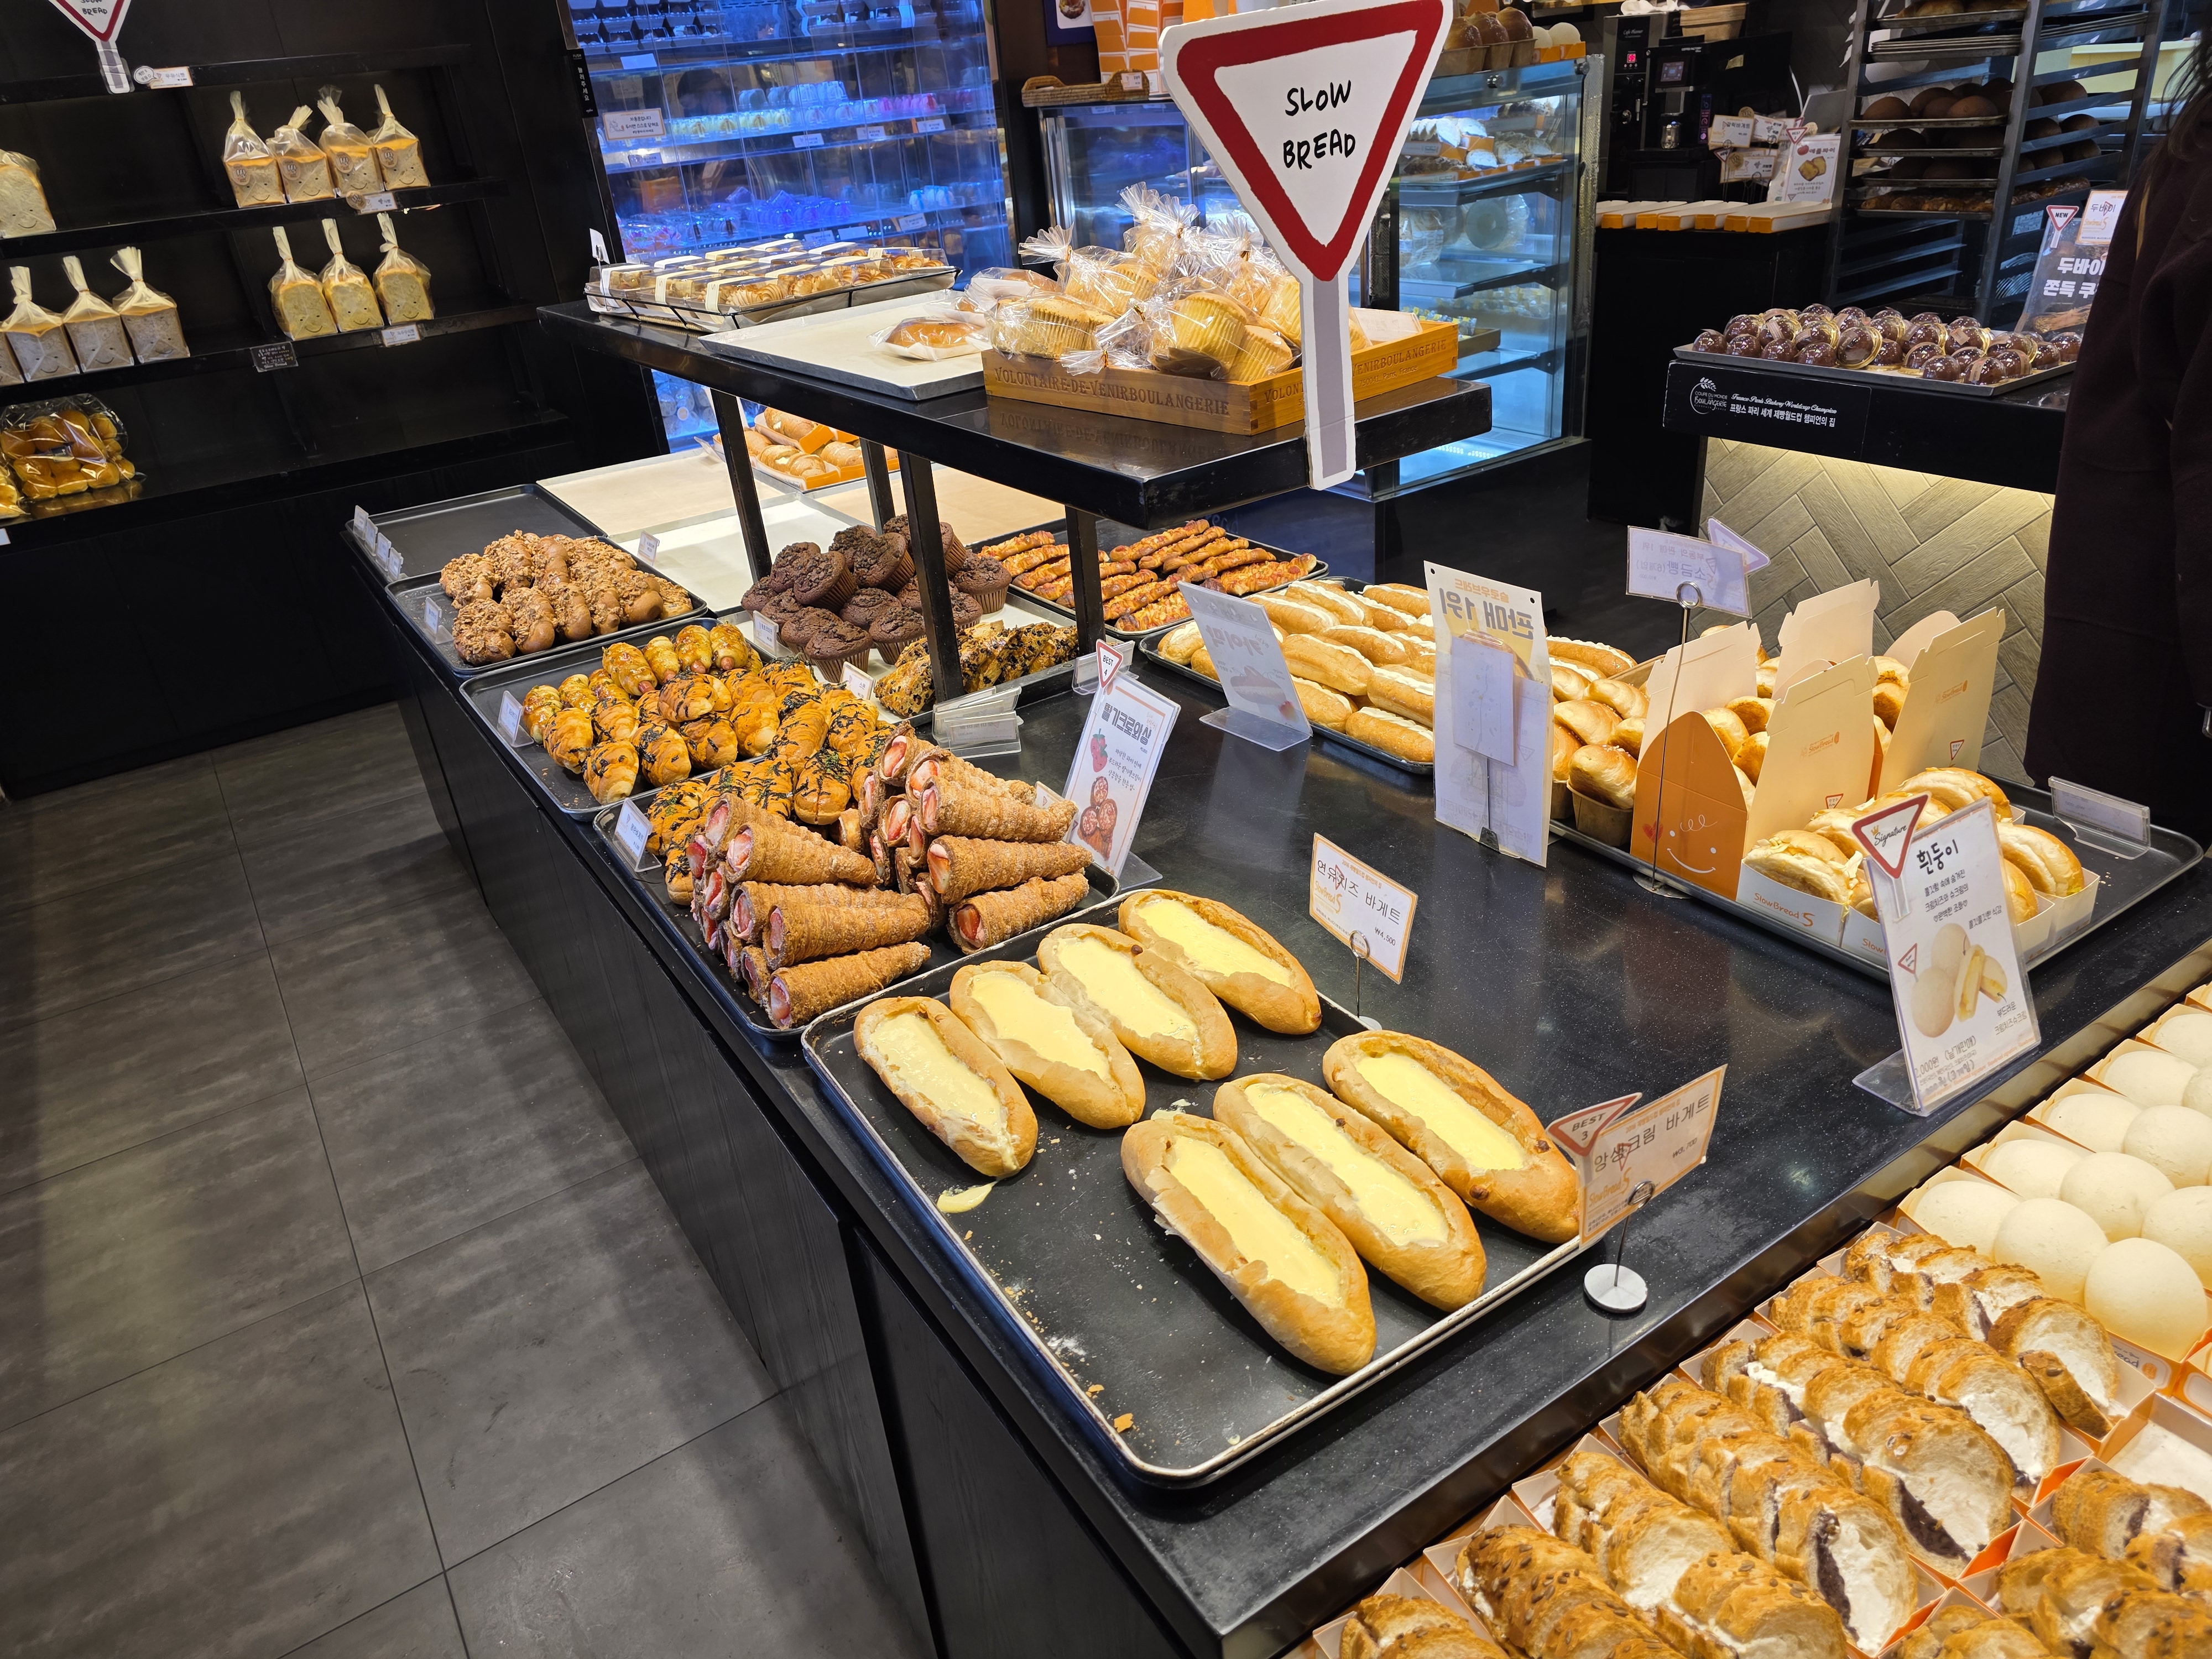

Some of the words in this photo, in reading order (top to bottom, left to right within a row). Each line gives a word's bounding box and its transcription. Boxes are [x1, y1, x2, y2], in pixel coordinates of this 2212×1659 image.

[82, 7, 108, 15] BREAD
[1285, 80, 1351, 116] SLOW
[1283, 128, 1355, 170] BREAD
[2090, 204, 2116, 213] 두바이
[2057, 258, 2106, 276] 두바이
[2043, 279, 2077, 298] 쫀득
[2078, 282, 2099, 299] 쿠
[1400, 365, 1418, 375] France
[1731, 393, 1749, 401] France
[1764, 398, 1785, 408] Bakery
[1784, 400, 1811, 411] Worldcup
[1811, 404, 1837, 414] Champion
[1729, 404, 1746, 414] 프랑스
[1747, 405, 1760, 416] 파리
[1761, 408, 1773, 418] 세계
[1773, 410, 1803, 422] 제빵월드컵
[1804, 414, 1827, 426] 챔피언의
[1829, 418, 1836, 427] 집
[1103, 655, 1114, 667] BEST
[1102, 702, 1152, 745] 딸기크로와상
[1108, 757, 1121, 770] 부드러운
[1126, 755, 1134, 764] 파이
[1874, 825, 1907, 848] Signature
[1916, 838, 1959, 875] 흰둥이
[1940, 878, 1950, 889] 속에
[1951, 869, 1966, 883] 숨겨진
[1317, 859, 1359, 898] 연유치즈
[1365, 892, 1401, 925] 바게트
[1925, 893, 1949, 912] 크림치즈와
[1949, 883, 1969, 899] 슈크림의
[1754, 893, 1799, 920] SlowBread
[1992, 905, 2002, 917] 식감
[1375, 927, 1396, 946] ₩4,500
[1996, 1001, 2017, 1018] 부드러운
[1994, 1010, 2028, 1036] 크림치즈슈크림
[1944, 1035, 1976, 1061] (낱개판매)
[1572, 1112, 1606, 1132] BEST
[1581, 1131, 1588, 1141] 3
[1594, 1124, 1656, 1173] 앙생크림
[1666, 1094, 1710, 1131] 바게트
